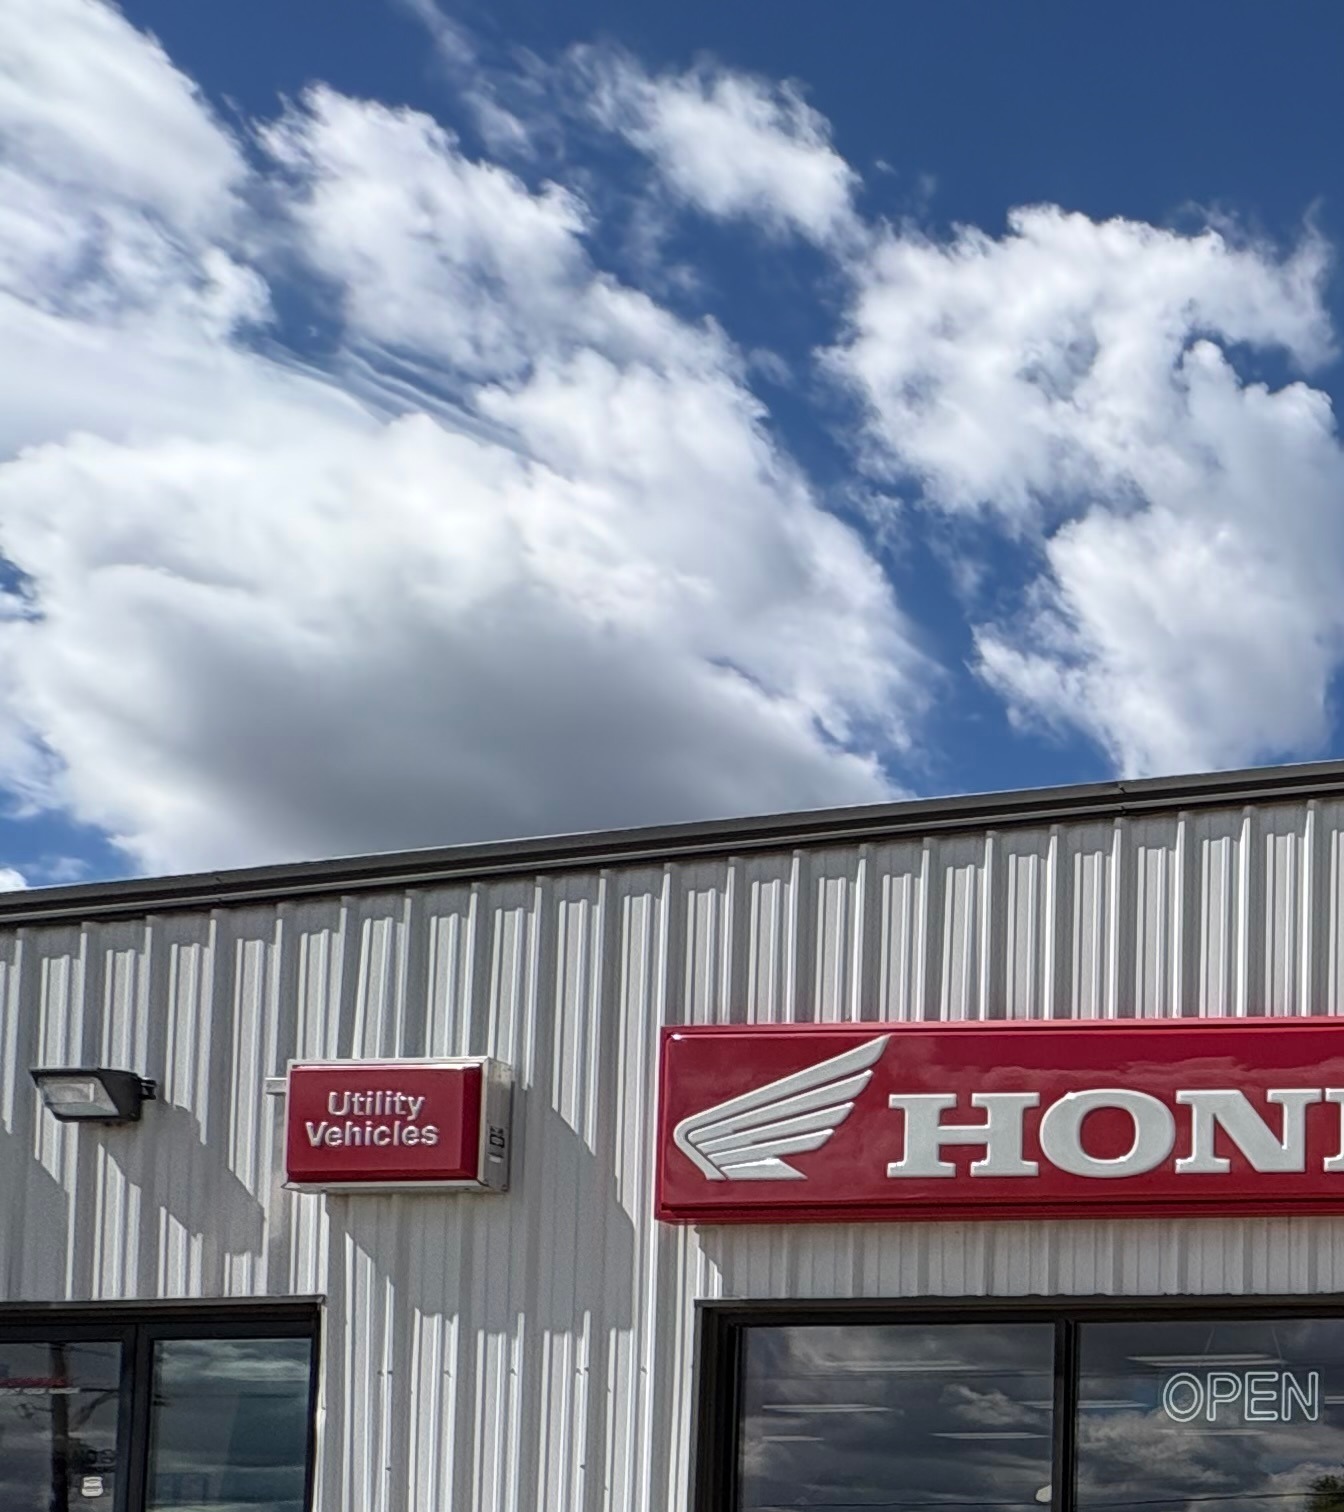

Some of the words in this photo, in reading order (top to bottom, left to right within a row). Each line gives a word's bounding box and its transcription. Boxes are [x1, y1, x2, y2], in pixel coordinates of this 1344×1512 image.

[328, 1090, 425, 1121] Utility
[305, 1120, 440, 1146] Vehicles
[1161, 1370, 1319, 1423] OPEN
